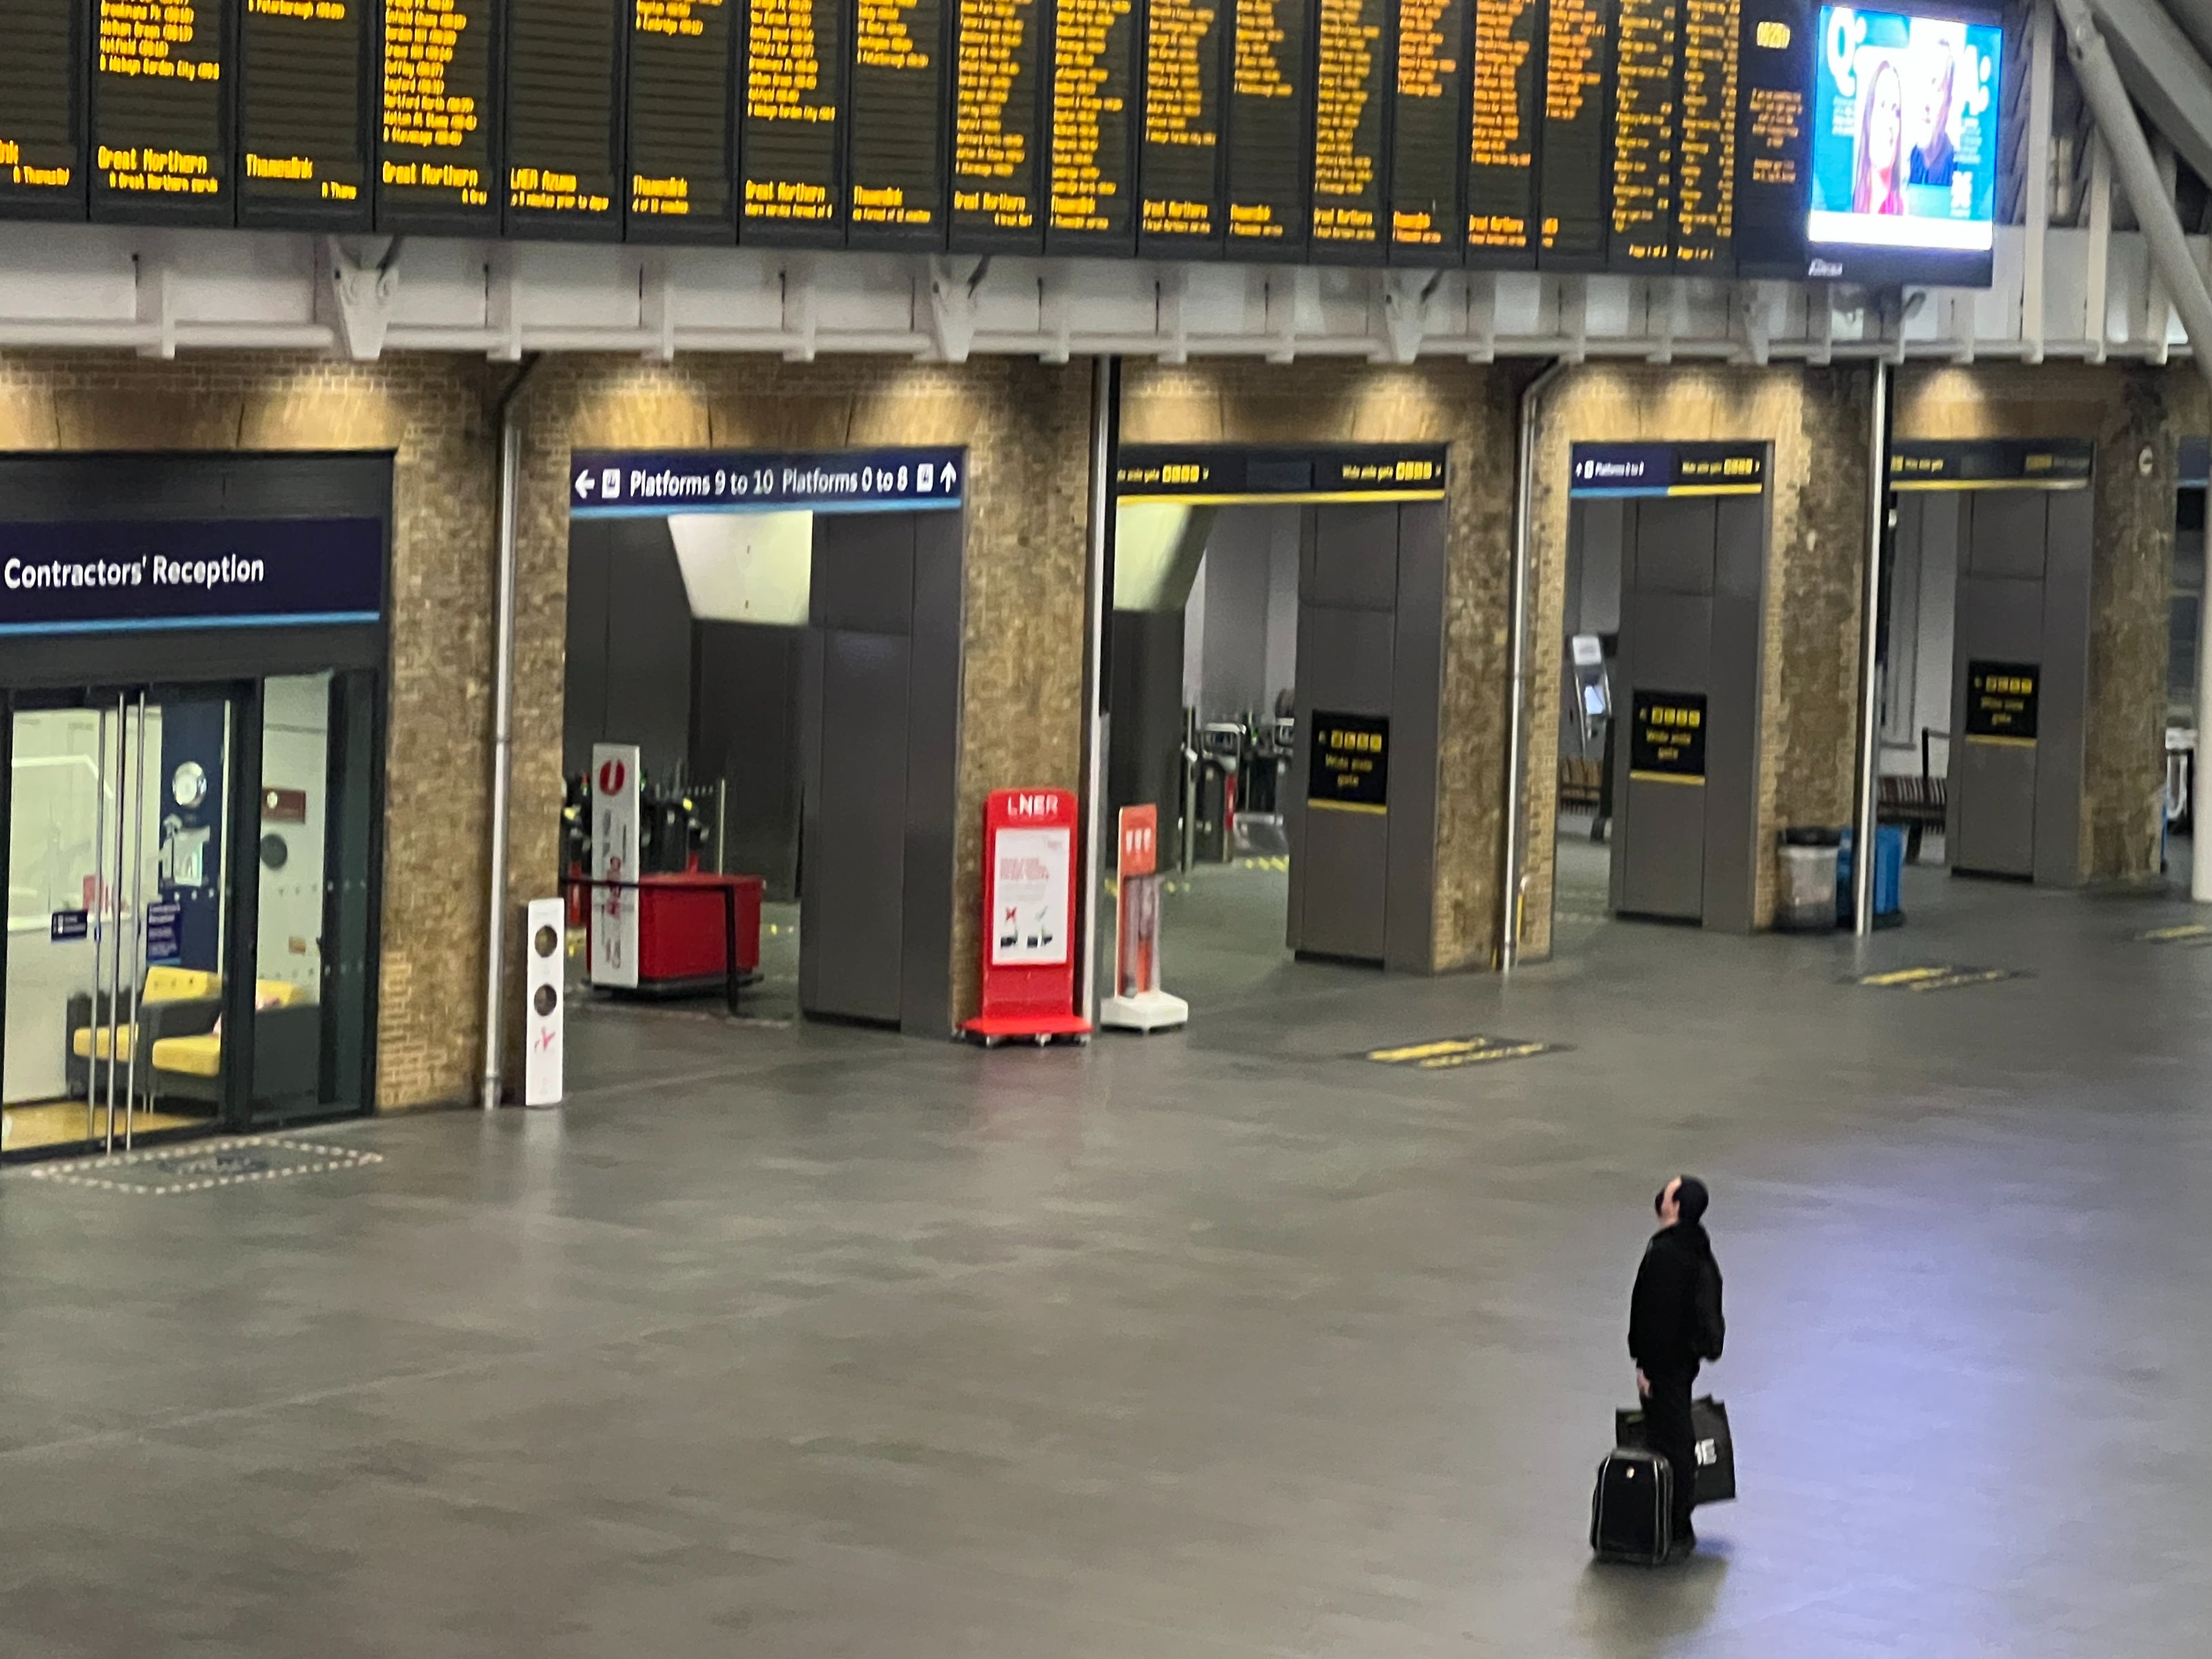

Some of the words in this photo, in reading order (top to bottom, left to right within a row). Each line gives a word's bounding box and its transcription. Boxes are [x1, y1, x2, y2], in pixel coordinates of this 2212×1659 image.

[629, 469, 710, 497] Platforms
[713, 469, 726, 495] 9
[729, 469, 748, 495] to
[751, 468, 774, 495] 10
[782, 467, 858, 495] Platforms
[860, 465, 872, 493] 0
[876, 465, 895, 493] to
[896, 464, 909, 492] 8
[3, 551, 148, 589] Contractors'
[152, 553, 265, 589] Reception
[1008, 793, 1058, 818] LNER
